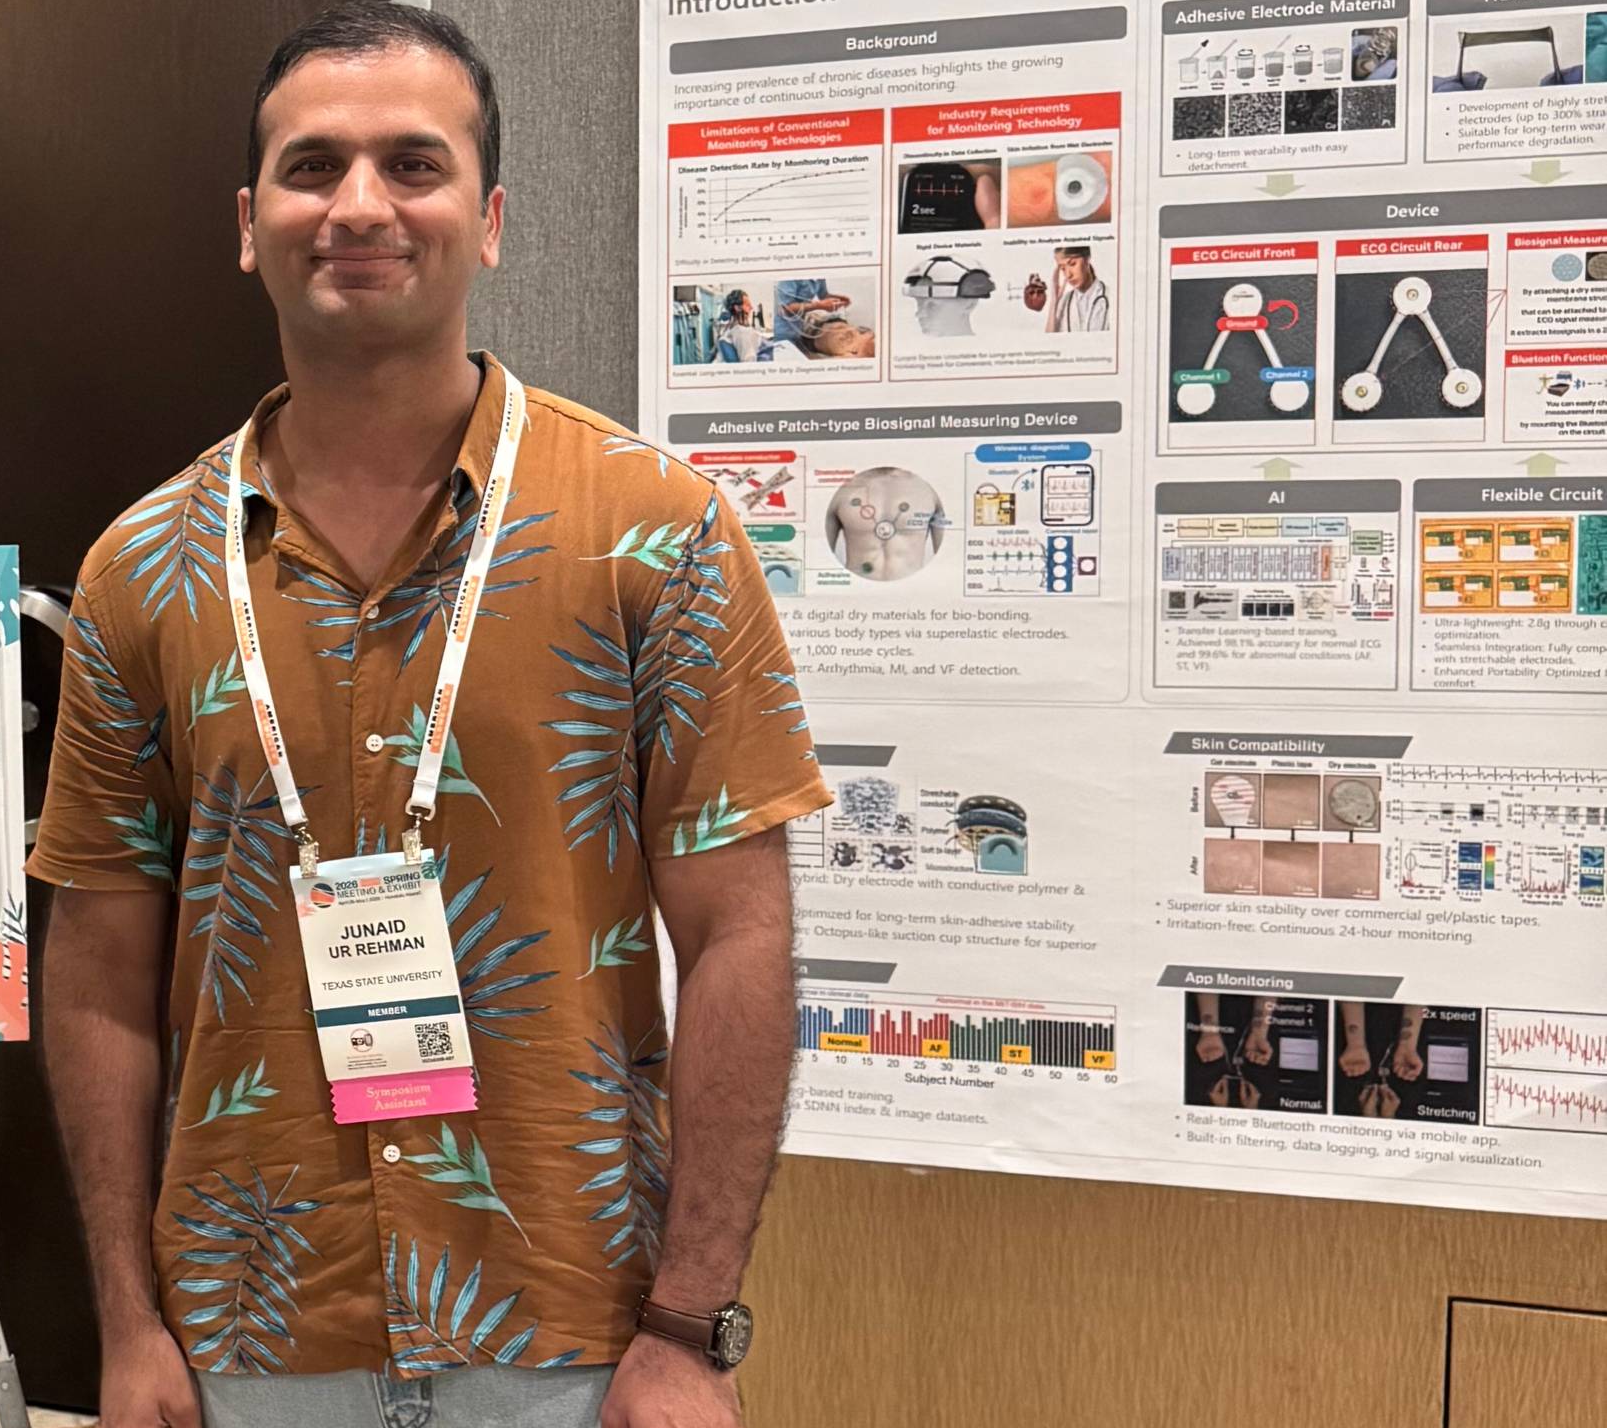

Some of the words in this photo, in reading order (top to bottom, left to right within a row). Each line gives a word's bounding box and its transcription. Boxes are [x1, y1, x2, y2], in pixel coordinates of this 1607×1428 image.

[1176, 6, 1246, 24] Adhesive
[1252, 1, 1325, 20] Electrode
[846, 32, 937, 51] Background
[674, 75, 732, 94] Increasing
[736, 73, 799, 91] prevalence
[803, 72, 815, 84] of
[819, 68, 863, 83] chronic
[867, 64, 917, 81] diseases
[922, 60, 983, 78] highlights
[987, 59, 1008, 71] the
[1011, 54, 1063, 71] growing
[674, 95, 740, 111] importance
[744, 92, 756, 104] of
[759, 88, 825, 104] continuous
[829, 83, 883, 101] biosignal
[939, 108, 987, 120] Industry
[990, 103, 1070, 116] Requirements
[701, 126, 759, 138] Limitations
[763, 123, 774, 133] of
[778, 118, 850, 132] Conventional
[927, 125, 943, 135] for
[948, 120, 1012, 133] Monitoring
[1017, 117, 1082, 129] Technology
[708, 138, 768, 150] Monitoring
[772, 134, 842, 145] Technologies
[1386, 205, 1439, 219] Device
[1361, 243, 1386, 253] ECG
[1390, 241, 1430, 252] Circuit
[1434, 240, 1463, 251] Rear
[1515, 237, 1561, 247] Biosignal
[1192, 251, 1218, 261] ECG
[1221, 248, 1260, 260] Circuit
[1264, 247, 1296, 258] Front
[1512, 355, 1561, 364] Bluetooth
[708, 421, 774, 435] Adhesive
[778, 418, 859, 434] Patch-type
[865, 415, 935, 433] Biosignal
[940, 413, 1020, 430] Measuring
[1024, 413, 1078, 426] Device
[1268, 492, 1285, 503] AI
[1482, 489, 1543, 501] Flexible
[1550, 488, 1603, 500] Circuit
[479, 479, 497, 531] AMERICAN
[452, 580, 469, 635] AMERICAN
[792, 610, 803, 620] &
[808, 609, 844, 623] digital
[848, 609, 867, 622] dry
[873, 610, 926, 620] materials
[930, 609, 948, 620] for
[953, 609, 1031, 622] bio-bonding.
[1555, 619, 1596, 629] through
[242, 601, 257, 653] AMERICAN
[789, 628, 830, 638] various
[835, 628, 864, 641] body
[870, 629, 900, 641] types
[905, 628, 922, 638] via
[927, 628, 997, 641] superelastic
[1002, 628, 1069, 639] electrodes.
[426, 688, 443, 745] AMERICAN
[264, 704, 283, 758] AMERICAN
[1192, 738, 1224, 750] Skin
[1228, 739, 1325, 754] Compatibility
[335, 880, 358, 890] 2026
[383, 873, 420, 884] SPRING
[337, 886, 376, 898] MEETING
[387, 881, 421, 892] EXHIBIT
[1167, 899, 1220, 913] Superior
[1226, 902, 1251, 913] skin
[1256, 904, 1306, 918] stability
[1311, 906, 1340, 917] over
[1345, 907, 1421, 921] commercial
[1426, 910, 1496, 924] gel/plastic
[341, 920, 406, 940] JUNAID
[329, 944, 351, 959] UR
[357, 936, 425, 956] REHMAN
[322, 980, 353, 991] TEXAS
[355, 976, 385, 987] STATE
[387, 971, 443, 984] UNIVERSITY
[1185, 973, 1213, 986] App
[1217, 974, 1293, 990] Monitoring
[368, 1005, 408, 1017] MEMBER
[1422, 1008, 1438, 1020] 2x
[1440, 1010, 1476, 1023] speed
[827, 1037, 863, 1047] Normal
[929, 1044, 942, 1052] AF
[1009, 1049, 1022, 1058] ST
[1092, 1055, 1104, 1064] VF
[905, 1073, 946, 1087] Subject
[950, 1076, 995, 1088] Number
[366, 1083, 431, 1099] Symposium
[374, 1097, 427, 1111] Assistant
[1280, 1097, 1322, 1109] Normal
[1418, 1105, 1476, 1121] Stretching
